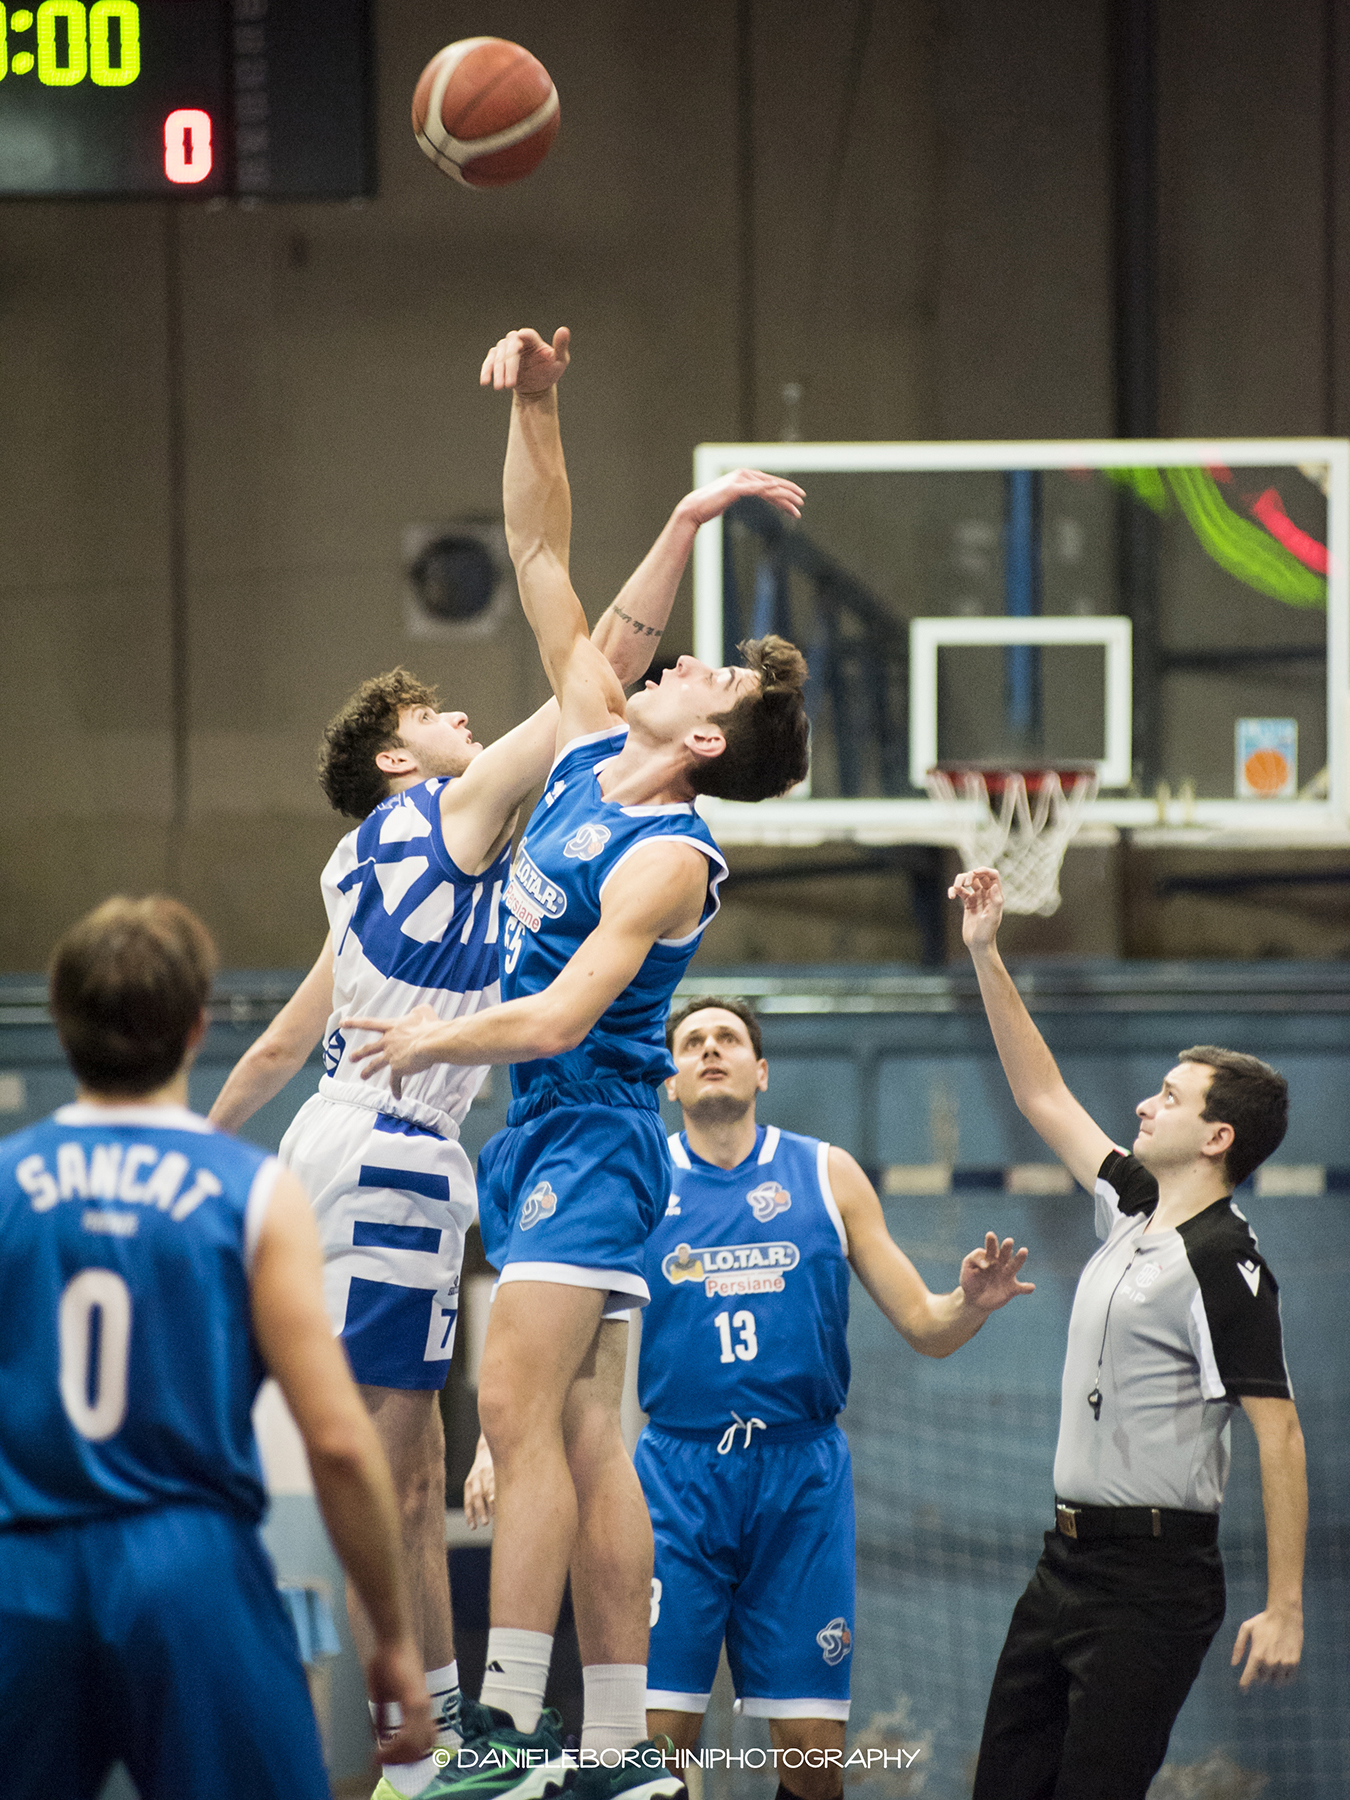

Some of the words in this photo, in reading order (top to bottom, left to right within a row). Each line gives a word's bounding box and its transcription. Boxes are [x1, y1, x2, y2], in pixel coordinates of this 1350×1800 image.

[0, 0, 140, 86] :00
[164, 108, 212, 184] 0
[504, 884, 540, 930] Persiane
[15, 1141, 223, 1223] SANCAT
[707, 1276, 783, 1295] Persiane
[1120, 1285, 1146, 1303] FIP
[58, 1267, 132, 1441] 0
[440, 1308, 458, 1349] 7
[713, 1309, 759, 1364] 13
